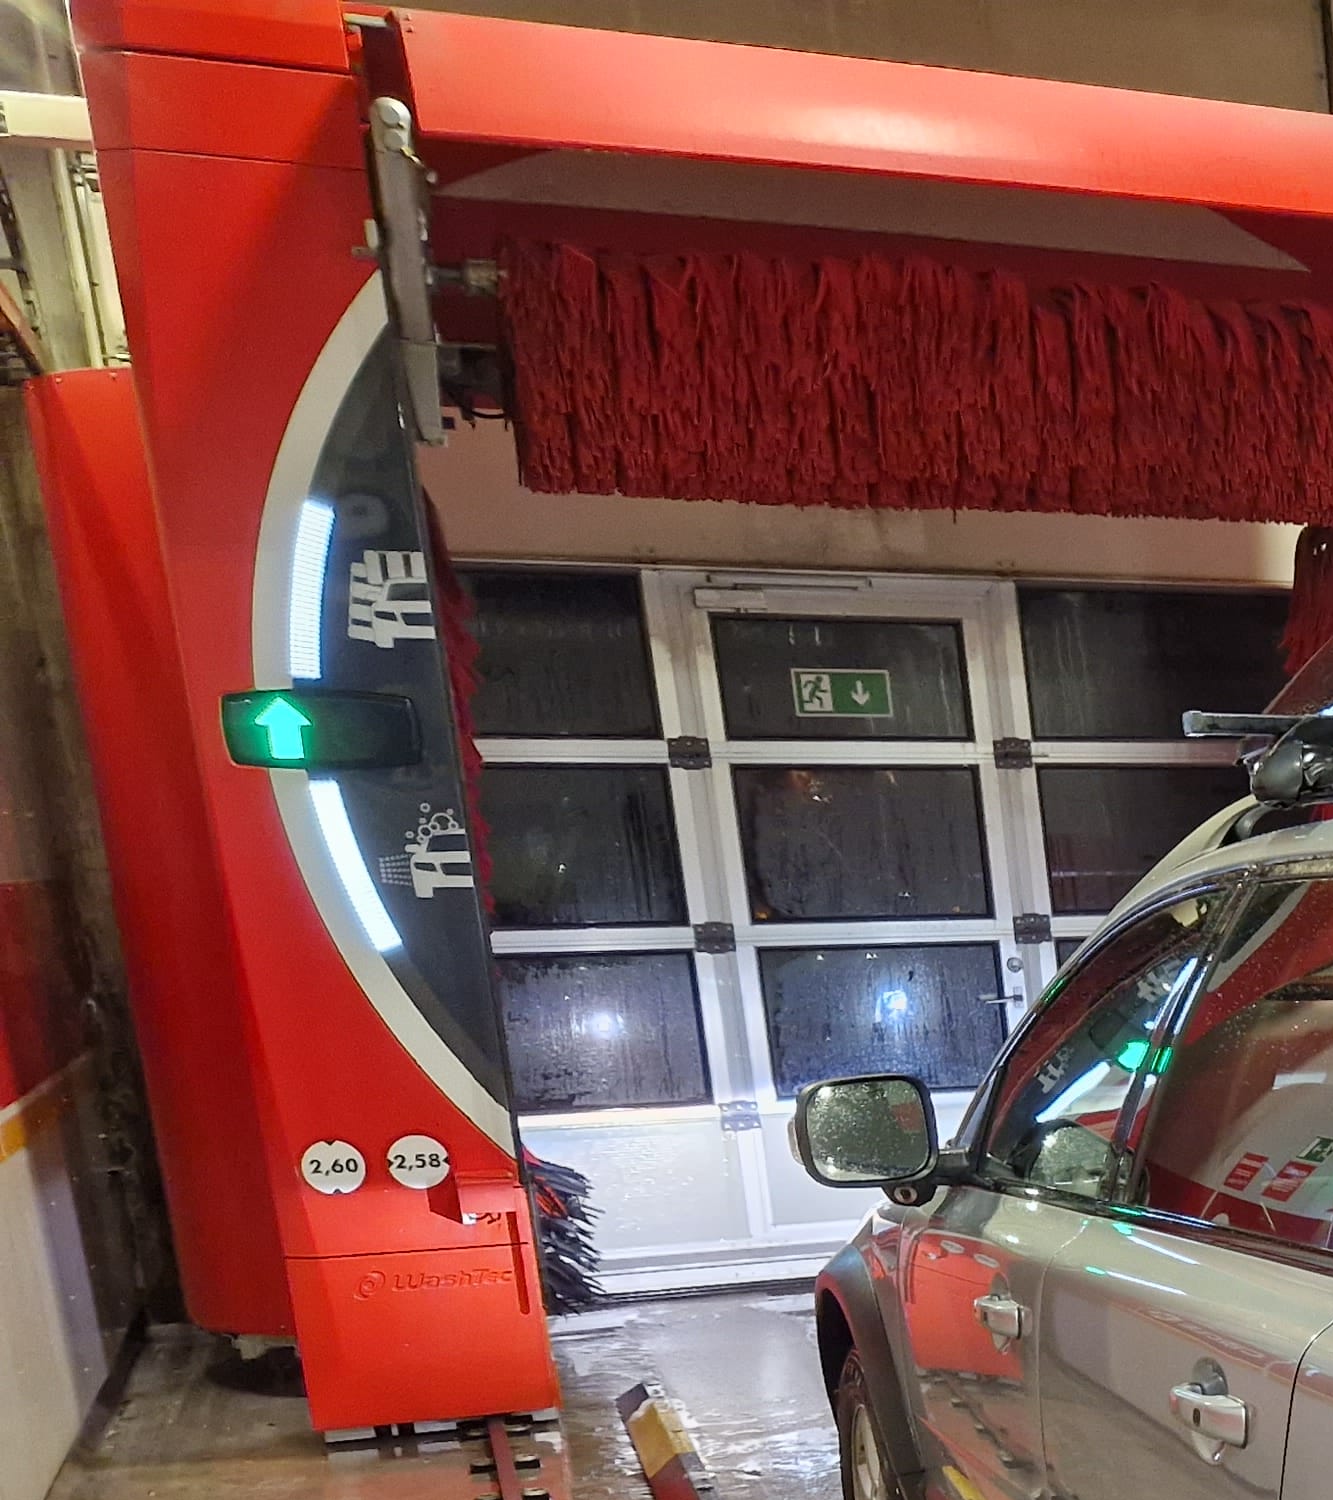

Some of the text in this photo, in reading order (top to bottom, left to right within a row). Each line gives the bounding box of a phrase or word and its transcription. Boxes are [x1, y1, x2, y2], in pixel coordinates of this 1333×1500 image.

[309, 1157, 359, 1177] 2,60
[393, 1153, 442, 1172] 2,58
[392, 1269, 513, 1291] WashTec
